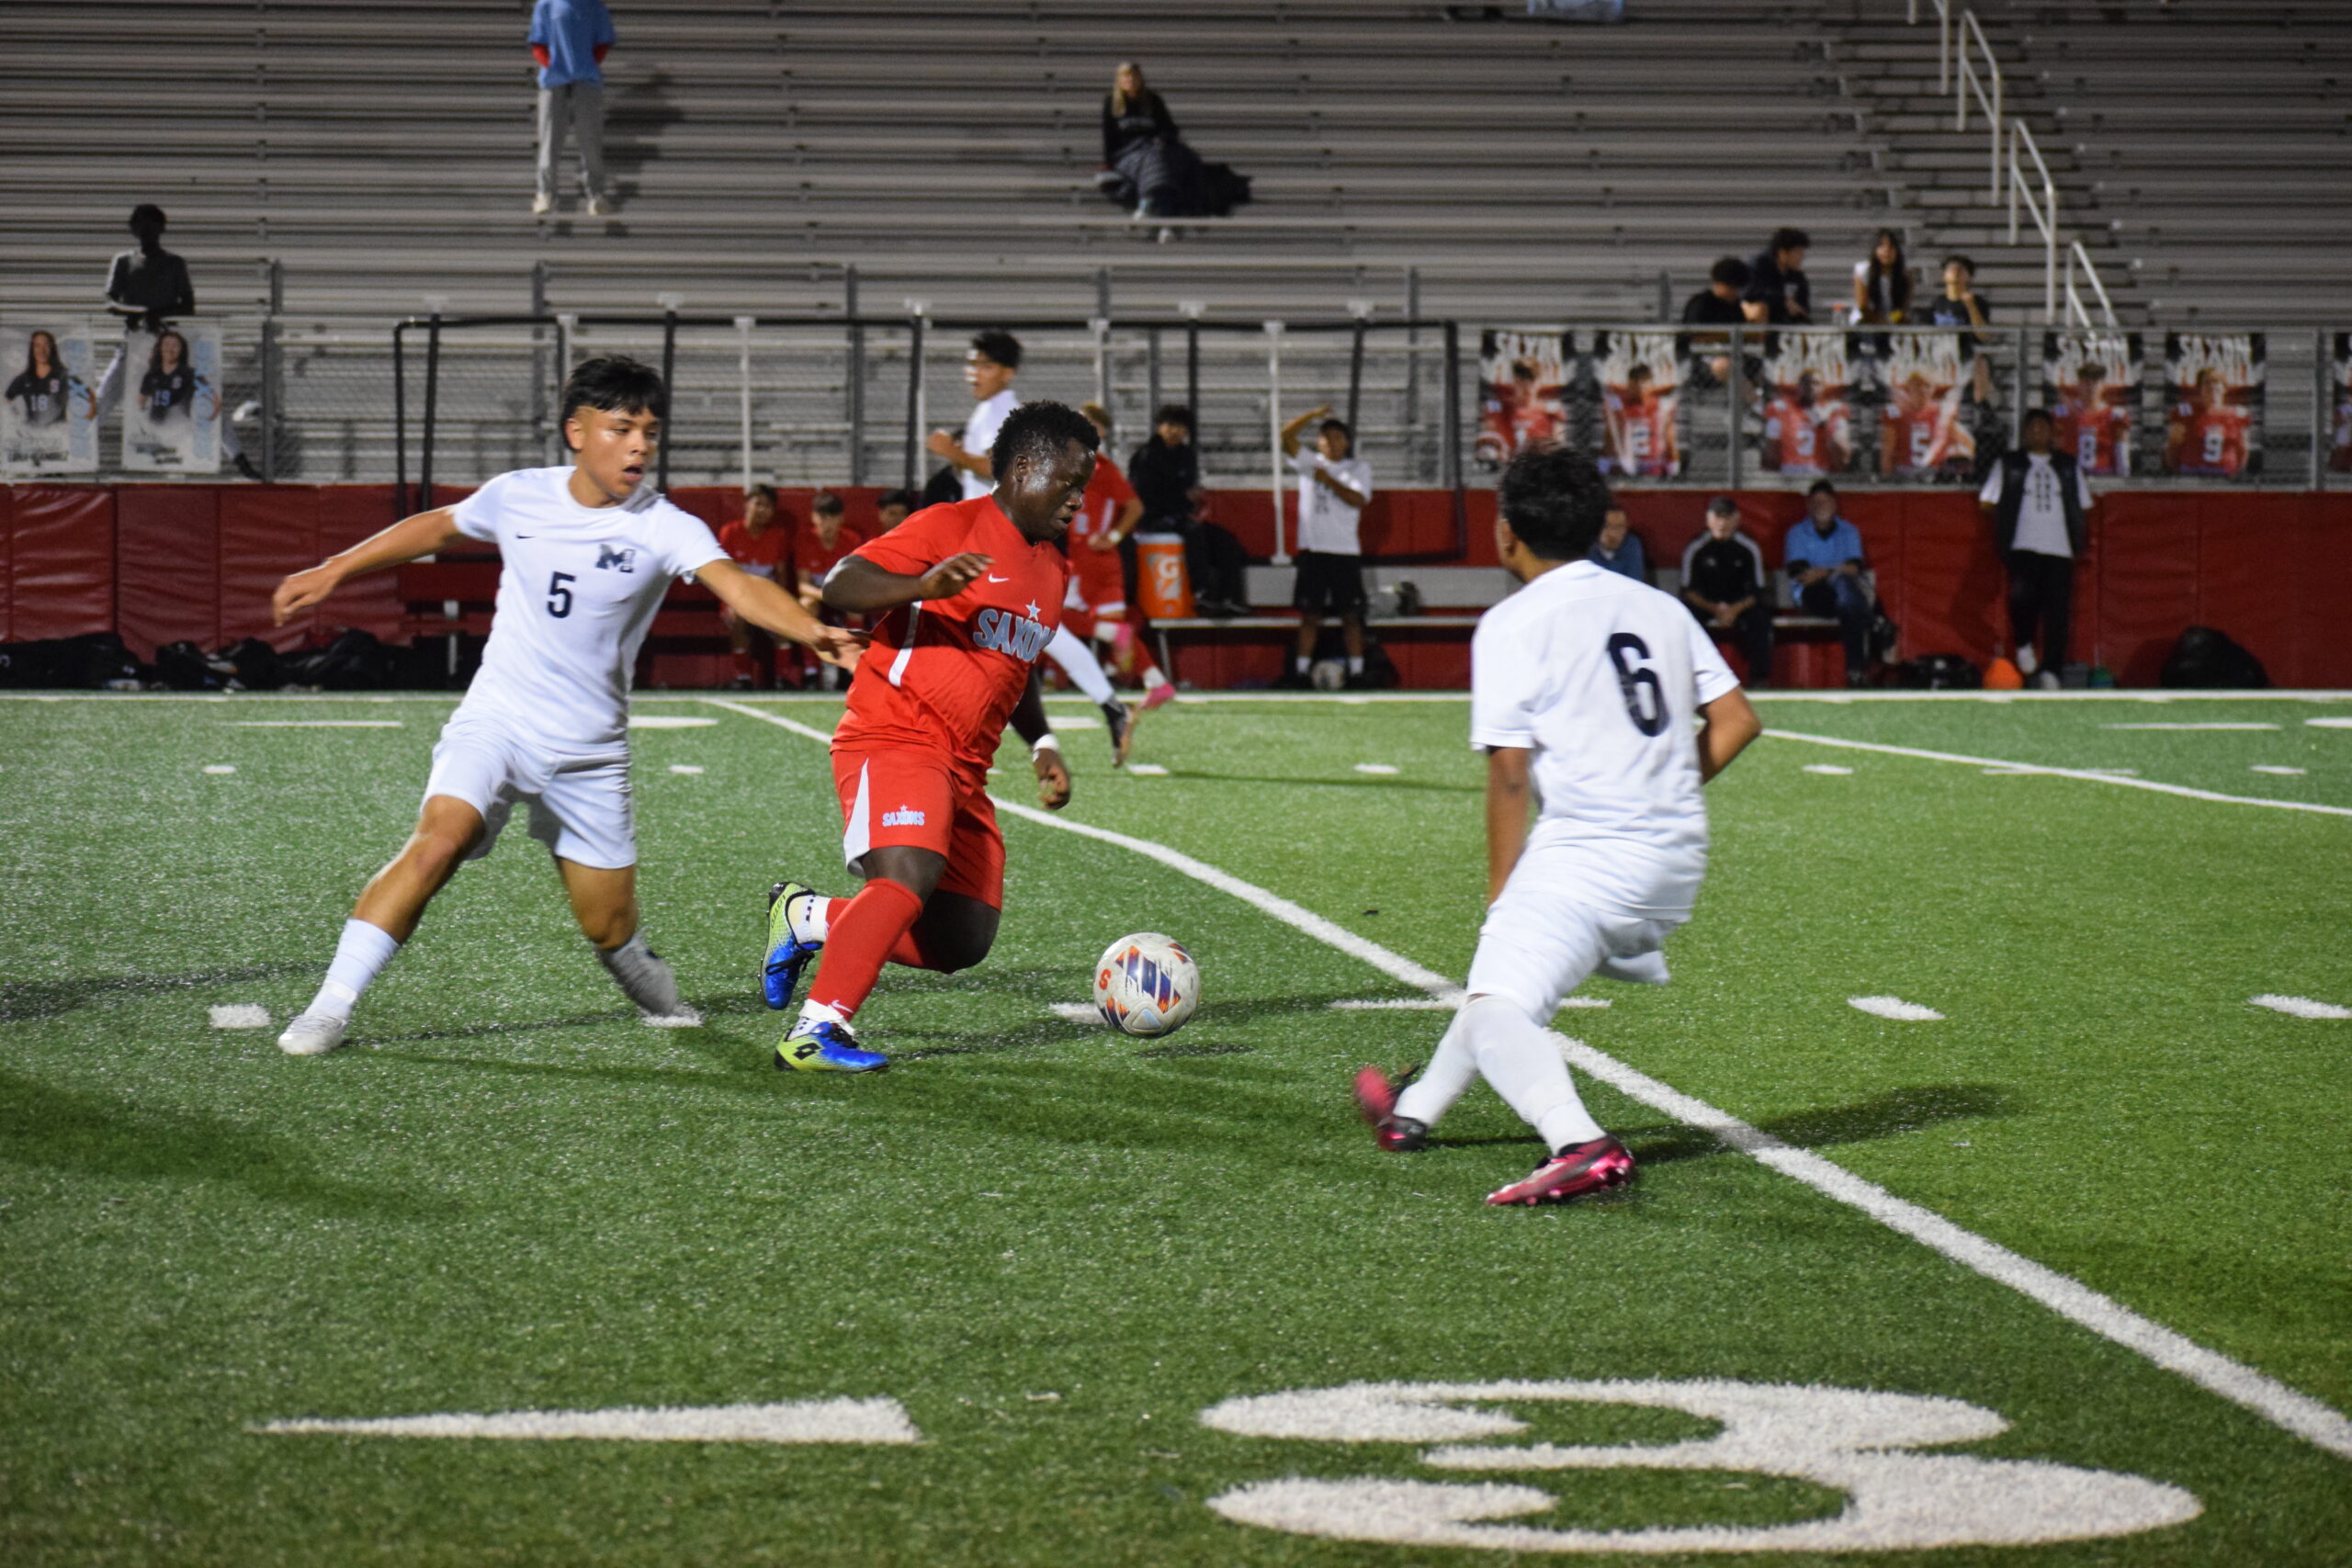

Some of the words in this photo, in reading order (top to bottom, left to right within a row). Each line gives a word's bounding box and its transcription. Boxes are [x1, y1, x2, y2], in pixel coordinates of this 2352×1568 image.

[548, 570, 576, 618] 5
[1607, 632, 1670, 738] 6
[882, 810, 925, 827] SAXONS
[1200, 1376, 2204, 1551] 3
